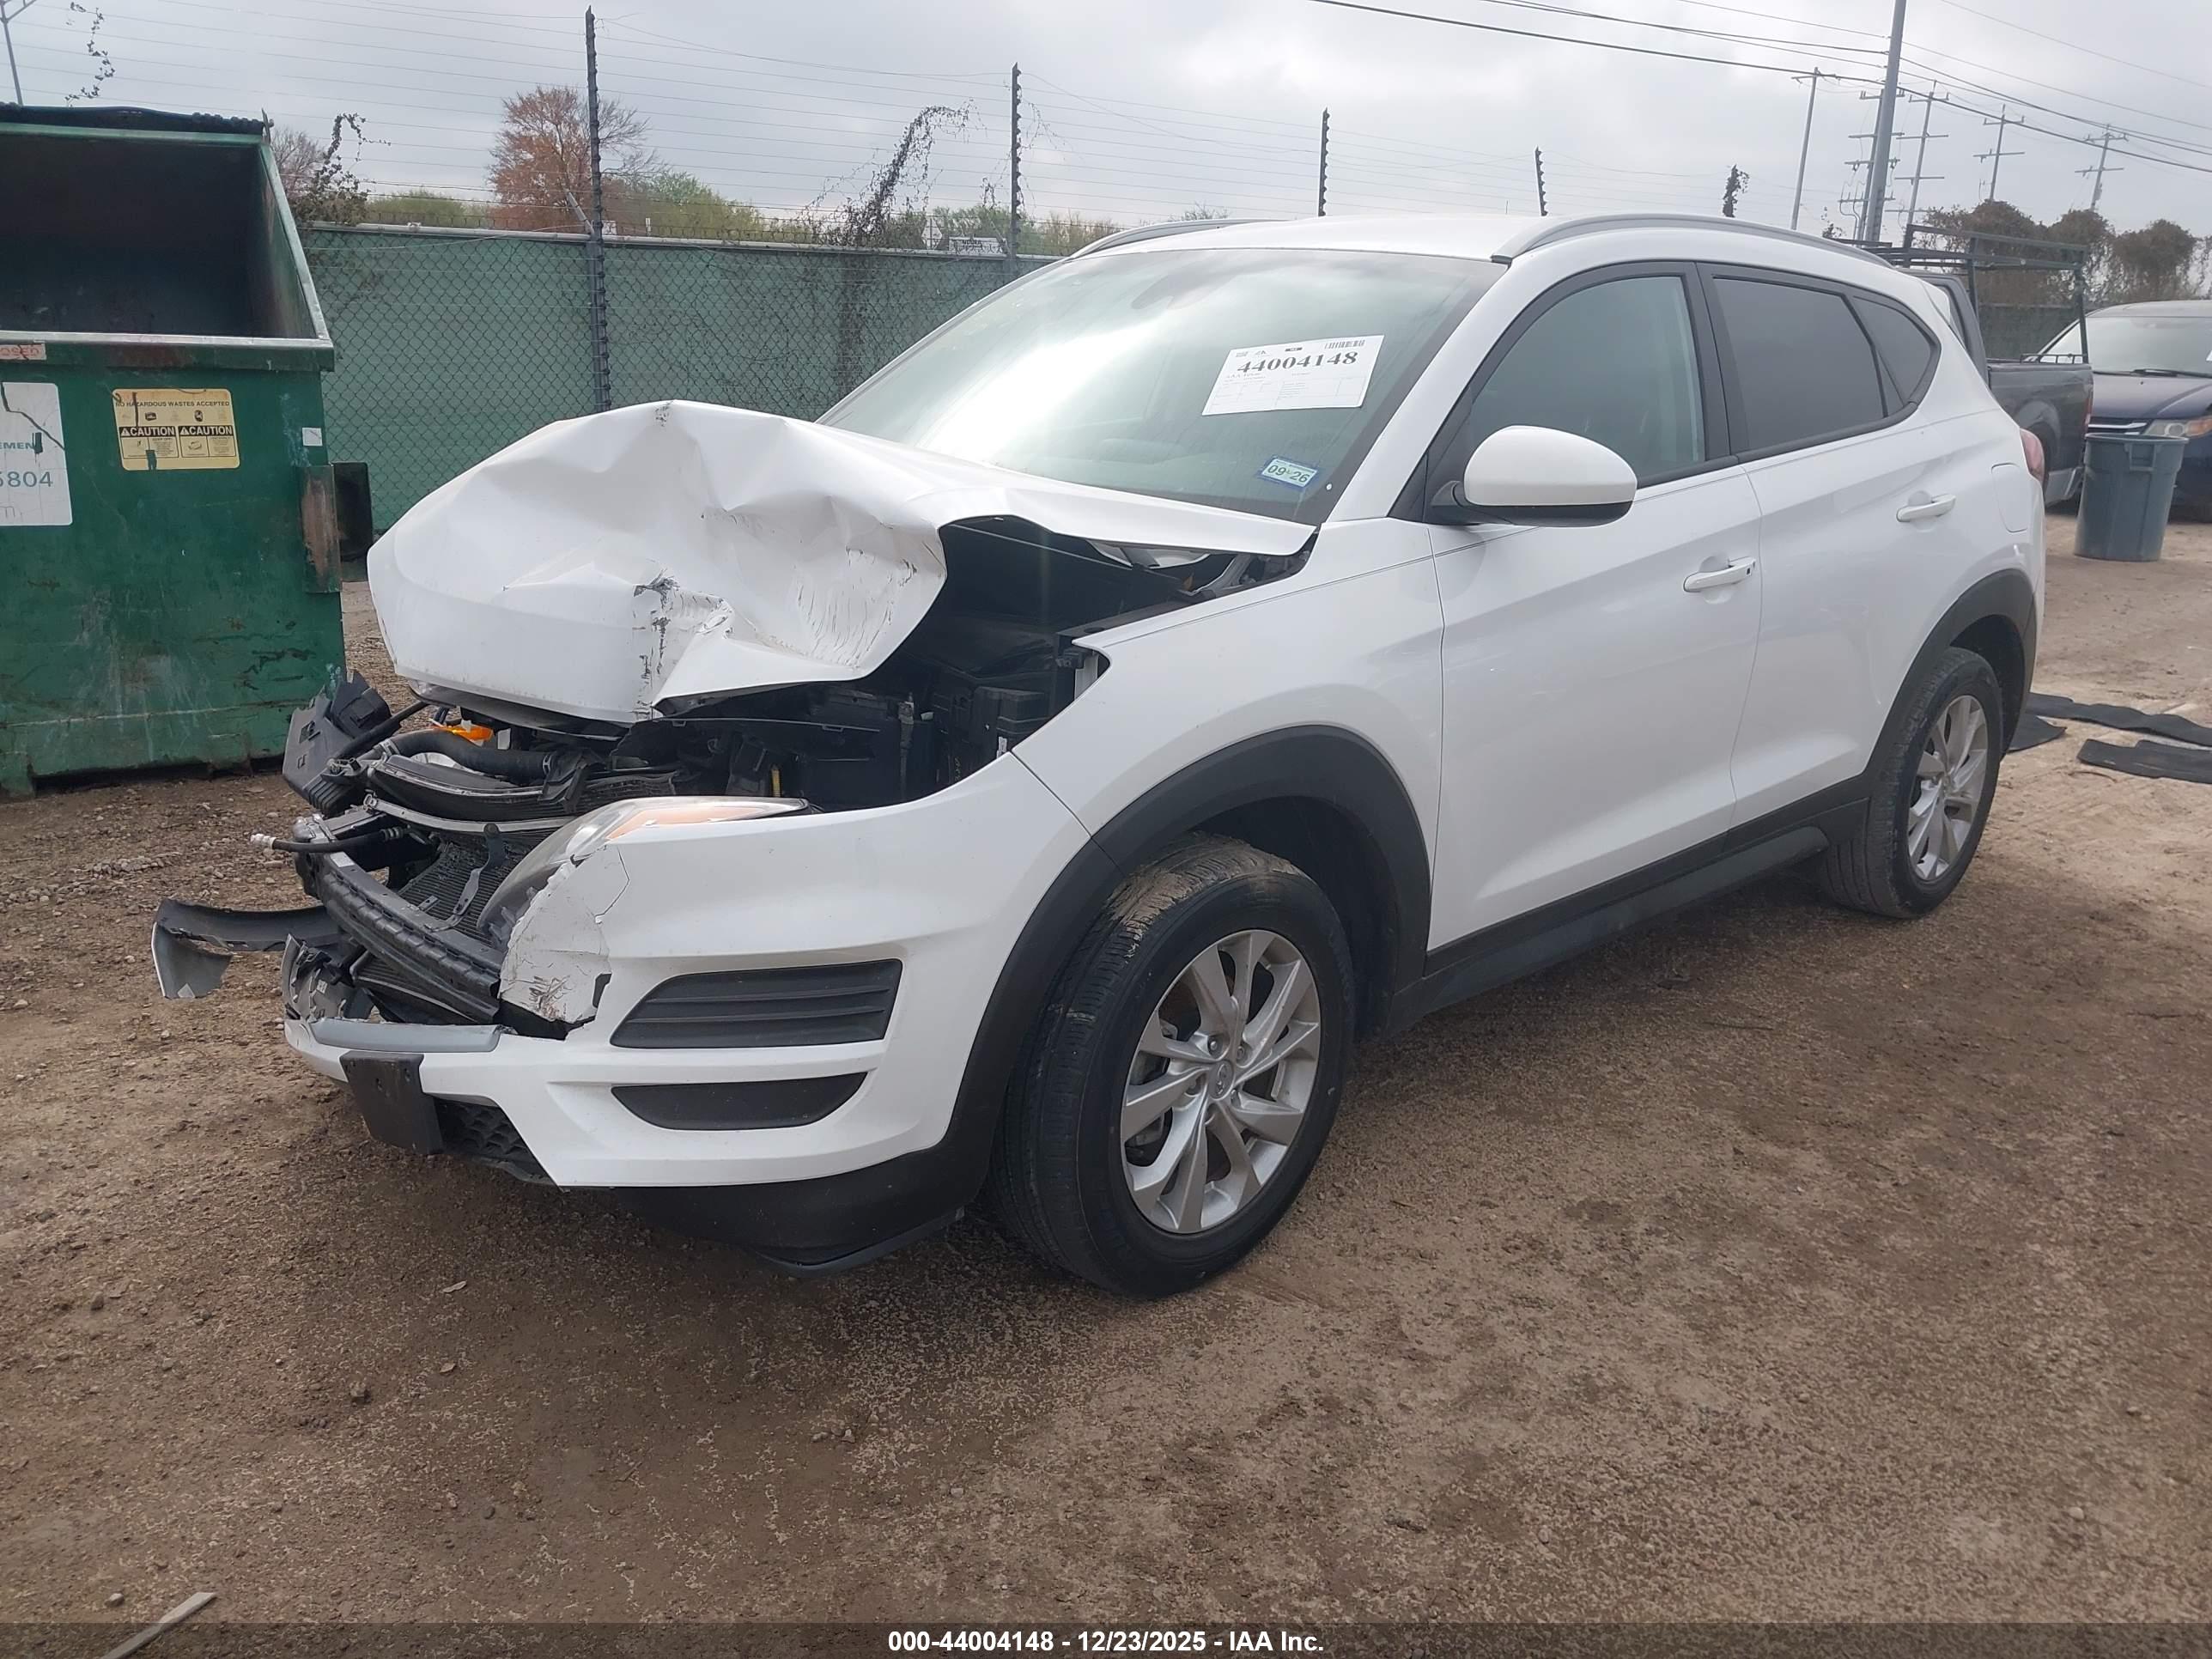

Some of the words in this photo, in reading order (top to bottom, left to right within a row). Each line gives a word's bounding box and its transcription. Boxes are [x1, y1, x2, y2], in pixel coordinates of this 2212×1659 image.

[1237, 351, 1358, 373] 44004148
[130, 426, 175, 436] CAUTION
[189, 426, 233, 435] CAUTION
[1267, 465, 1286, 476] 09
[1290, 471, 1310, 483] 26
